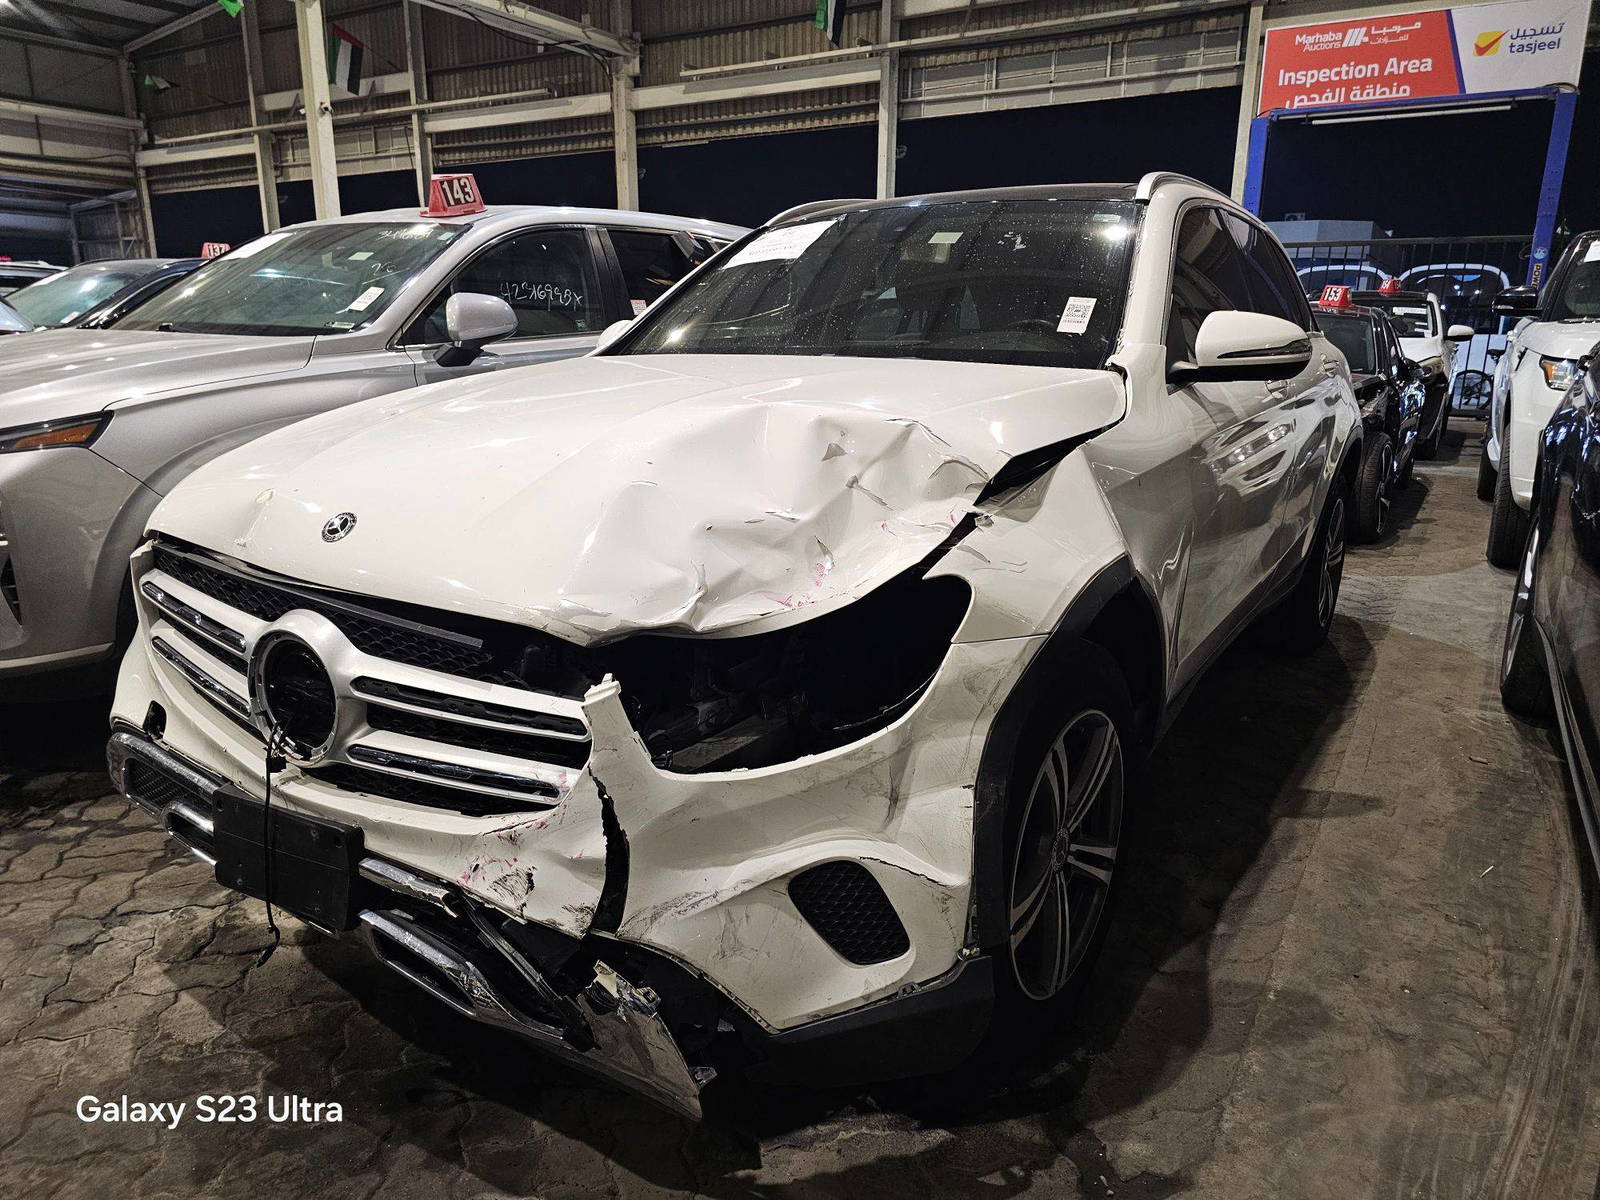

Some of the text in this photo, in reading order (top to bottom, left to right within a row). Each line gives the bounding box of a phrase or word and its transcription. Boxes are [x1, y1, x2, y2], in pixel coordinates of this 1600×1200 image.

[1295, 32, 1343, 46] Marhaba
[1510, 22, 1566, 41] تسجيل
[1303, 41, 1342, 52] Auctions
[1509, 38, 1561, 54] tasjeel
[1278, 57, 1433, 88] Inspection Area
[1350, 82, 1411, 101] منطقة
[442, 177, 475, 206] 143
[1324, 287, 1342, 302] 153
